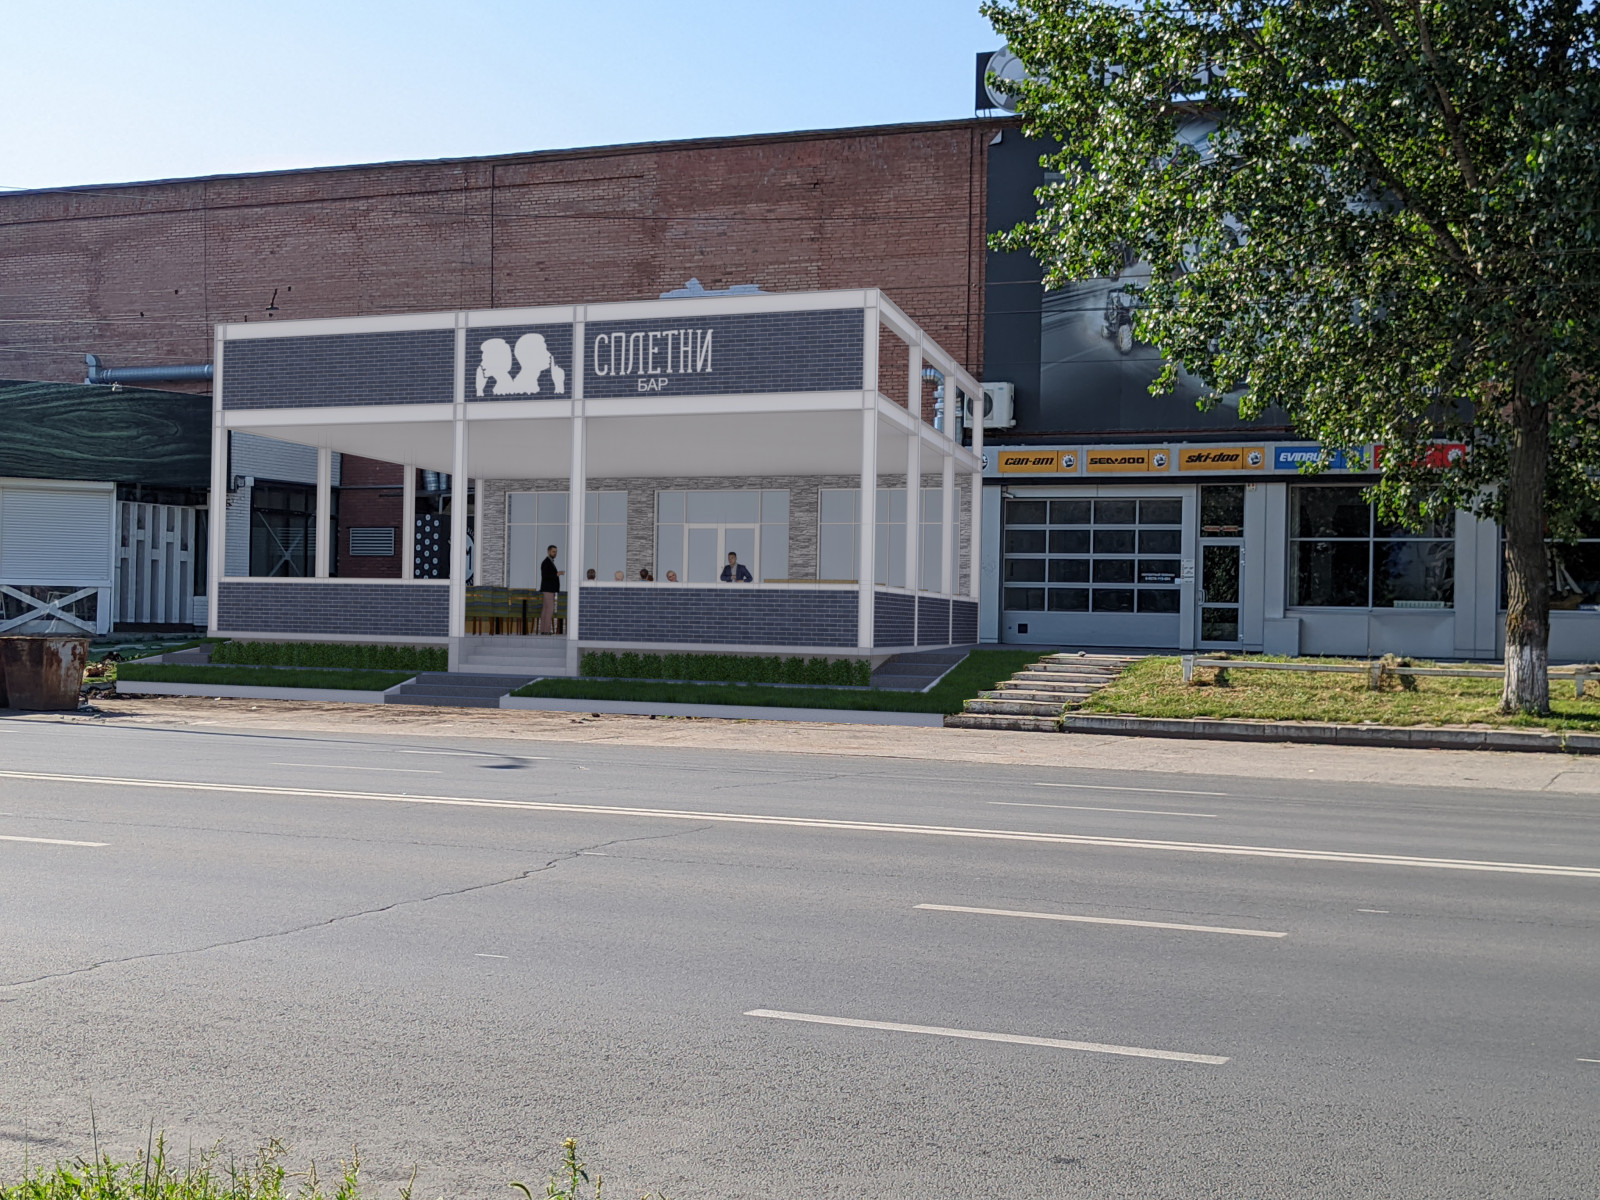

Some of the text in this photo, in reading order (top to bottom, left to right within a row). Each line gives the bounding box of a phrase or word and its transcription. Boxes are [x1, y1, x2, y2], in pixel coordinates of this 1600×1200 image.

[594, 329, 714, 376] СПЛЕТНИ
[637, 378, 669, 392] БАР
[1185, 452, 1240, 463] ski-doo
[1279, 452, 1337, 462] EVINRU
